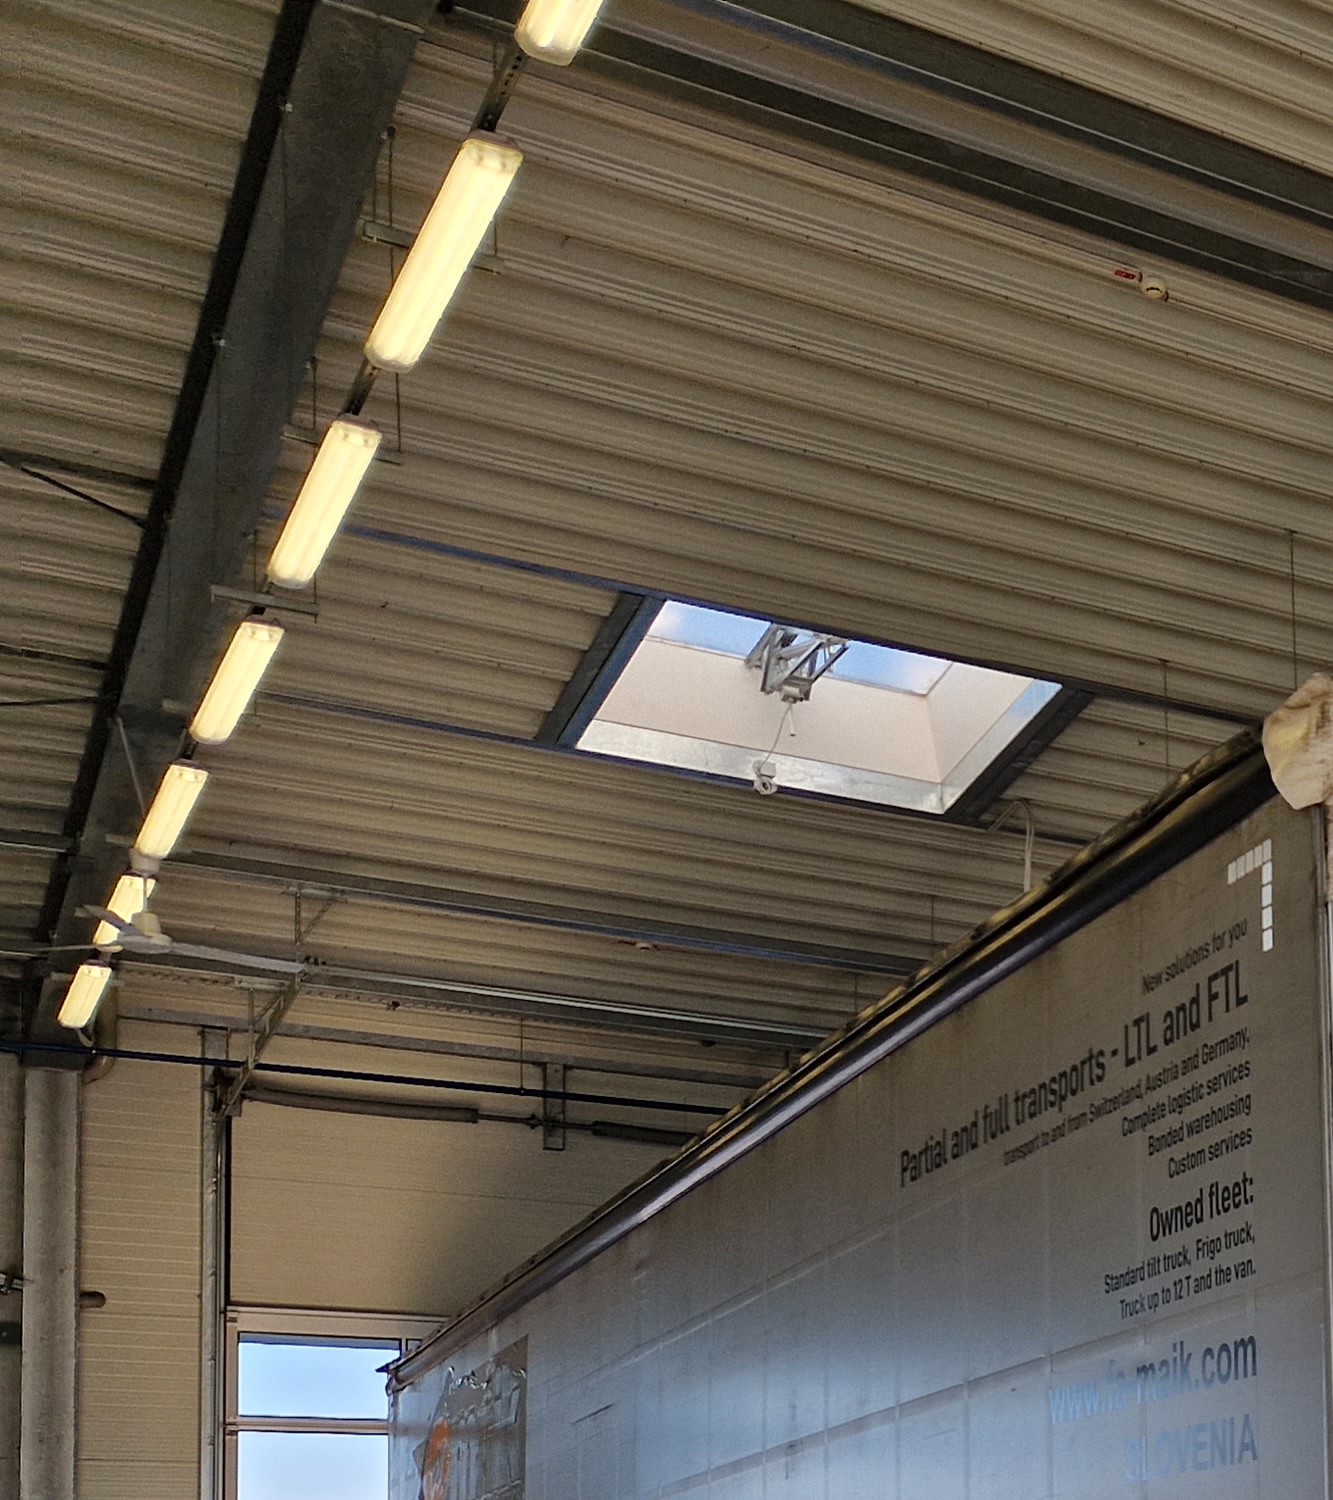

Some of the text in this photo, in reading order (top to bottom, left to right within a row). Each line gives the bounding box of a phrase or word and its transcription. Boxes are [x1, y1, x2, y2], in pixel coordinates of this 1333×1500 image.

[1142, 917, 1247, 996] New solutions for you
[900, 1132, 948, 1188] Partial
[951, 1111, 979, 1156] and
[982, 1093, 1010, 1145] full
[1015, 1045, 1106, 1126] transports
[1124, 1011, 1158, 1068] LTL
[1163, 983, 1201, 1046] and
[1208, 960, 1248, 1023] FTL
[1122, 1060, 1251, 1138] Complete logistic services
[1145, 1061, 1180, 1096] Austria
[1181, 1049, 1199, 1076] and
[1148, 1093, 1252, 1157] Bonded warehousing
[1168, 1127, 1252, 1180] Custom services
[1150, 1172, 1254, 1242] Owned fleet:
[1104, 1222, 1255, 1294] Standard tilt truck, Frigo truck,
[1120, 1258, 1256, 1320] Truck up to 12 T and the van.
[1125, 1413, 1258, 1482] SLOVENIA
